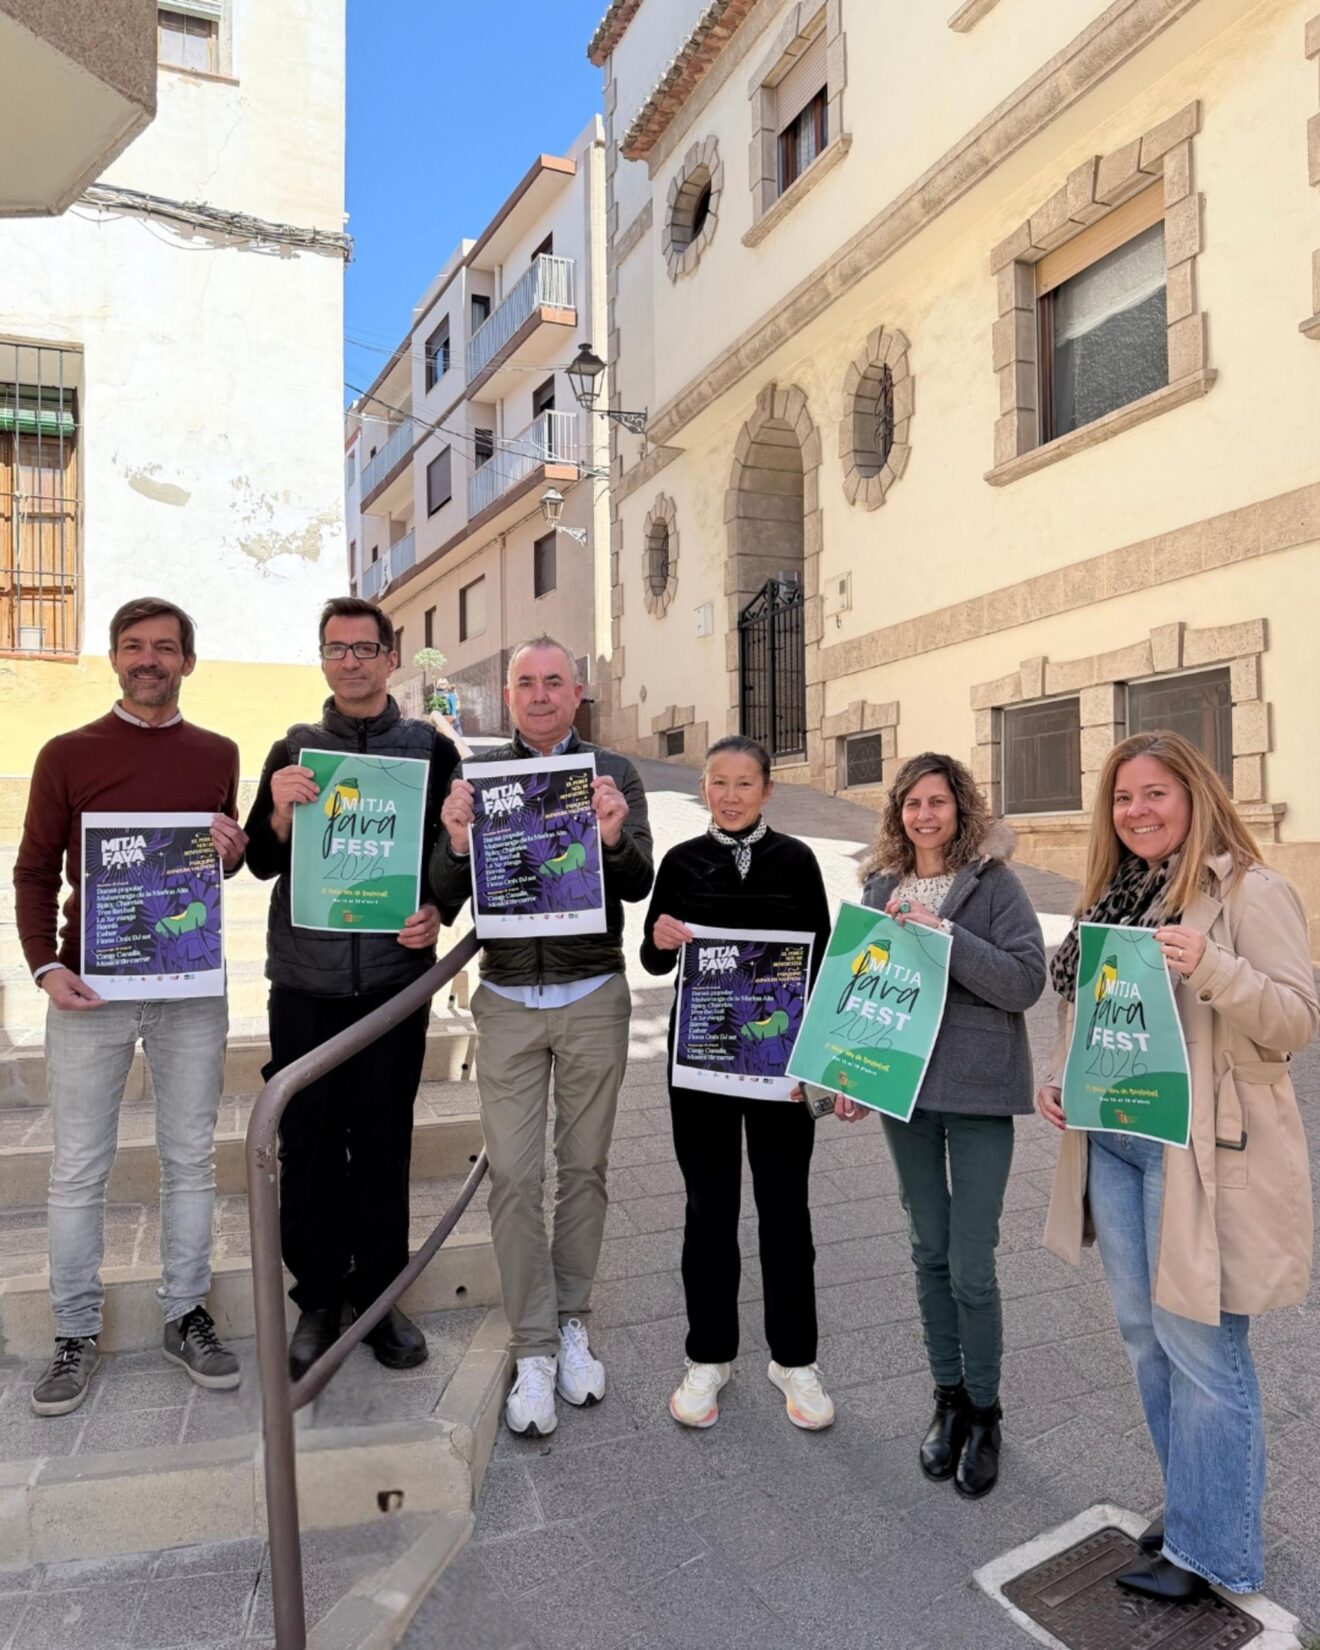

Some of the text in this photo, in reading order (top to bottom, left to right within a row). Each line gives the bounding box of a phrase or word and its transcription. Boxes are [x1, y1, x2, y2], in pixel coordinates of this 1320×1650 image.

[482, 782, 525, 802] MITJA
[342, 797, 396, 813] MITJA
[485, 796, 524, 815] FAVA
[101, 835, 147, 852] MITJA
[331, 838, 394, 858] FEST
[102, 848, 145, 866] FAVA
[323, 851, 385, 881] 2026
[699, 946, 740, 960] MITJA
[699, 957, 737, 972] FAVA
[869, 958, 921, 986] MITJA
[1104, 979, 1141, 1000] MITJA
[845, 995, 912, 1031] FEST
[830, 1010, 893, 1052] 2026
[1091, 1027, 1150, 1052] FEST
[1085, 1043, 1148, 1080] 2026
